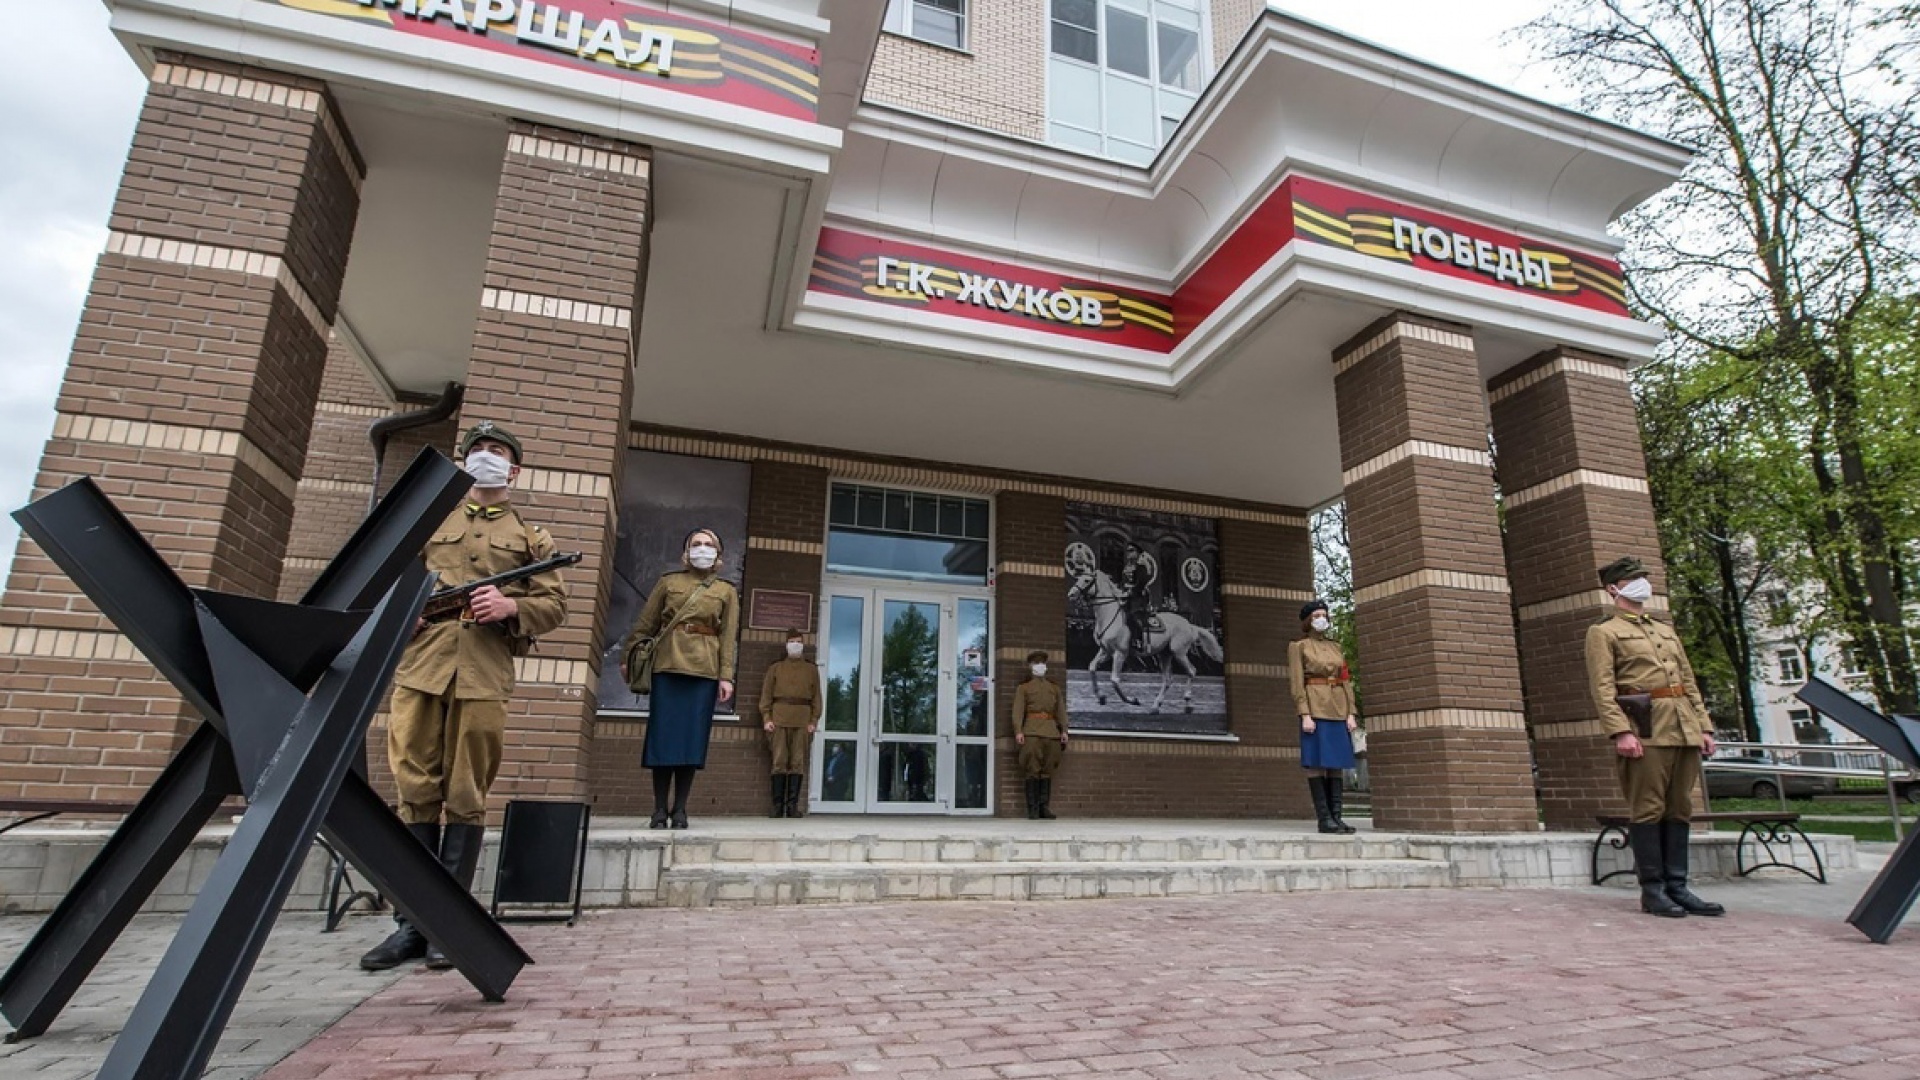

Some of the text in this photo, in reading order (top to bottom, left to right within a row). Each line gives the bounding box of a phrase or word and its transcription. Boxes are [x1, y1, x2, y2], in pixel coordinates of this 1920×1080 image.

[357, 0, 675, 73] АРШАЛ
[1393, 217, 1554, 290] ПОБЕДЫ
[877, 256, 1103, 326] Г.К. ЖУКОВ
